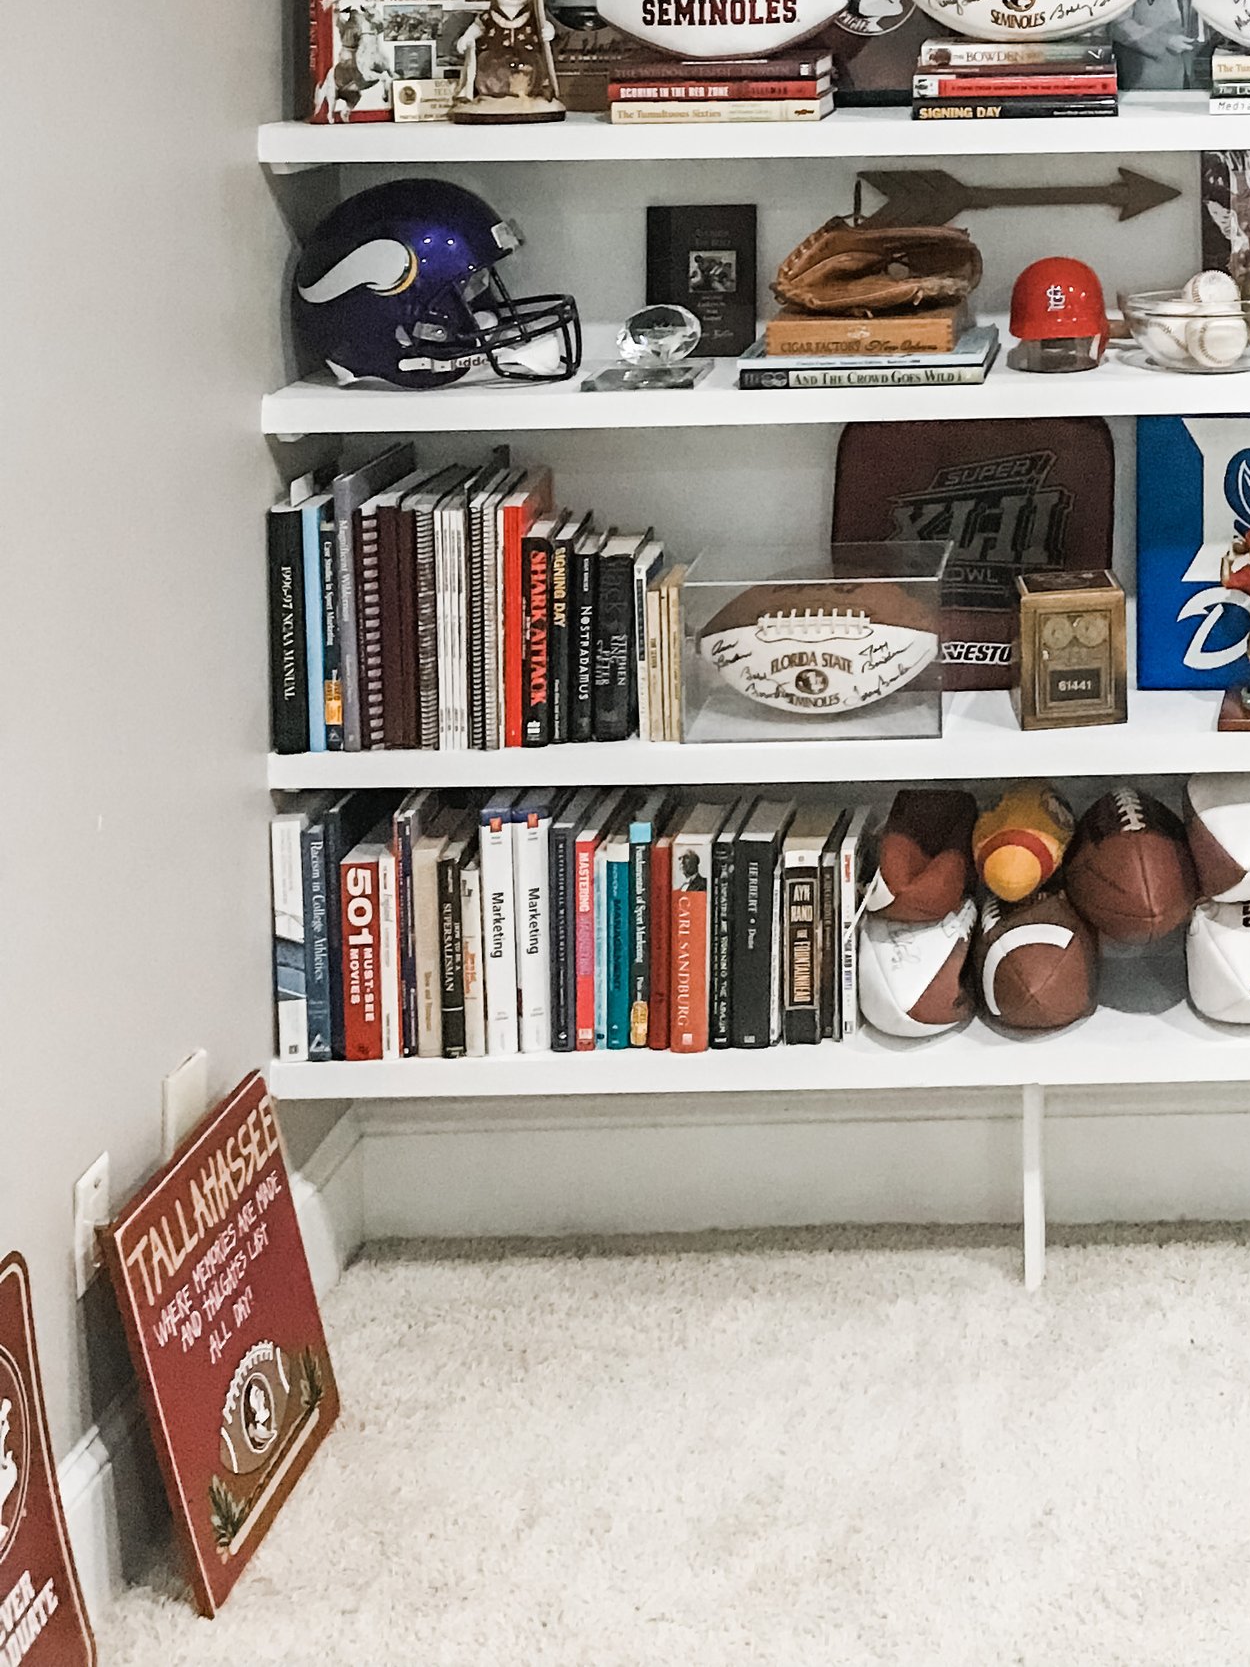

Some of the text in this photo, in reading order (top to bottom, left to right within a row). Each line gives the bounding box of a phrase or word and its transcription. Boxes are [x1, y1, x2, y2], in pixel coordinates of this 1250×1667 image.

[990, 9, 1046, 30] SEMINOLES
[966, 51, 1025, 63] BOWDEN
[1217, 63, 1234, 73] The
[617, 109, 722, 119] The Tumultuous Sixties
[671, 86, 686, 97] THE
[707, 86, 729, 97] ZONE
[918, 106, 1002, 119] SIGNING DAY
[781, 341, 860, 353] CIGAR FACTORY
[792, 370, 922, 385] AND THE CROWD GOES
[945, 460, 1031, 485] SUPER
[552, 547, 566, 628] SIGNING DAY
[280, 565, 296, 701] 1996-97 NCAA MANUAL
[325, 612, 336, 646] Marketing
[530, 550, 547, 707] SHARK ATTACK
[771, 651, 854, 675] FLORIDA STATE
[1057, 679, 1093, 692] 61441
[578, 852, 590, 912] MASTERING
[635, 845, 646, 895] Fundamentals
[748, 862, 758, 913] HERBERT
[309, 841, 327, 983] Racism in College Athletics
[491, 892, 505, 958] Marketing
[527, 887, 541, 954] Marketing
[634, 905, 646, 925] Sport
[346, 868, 375, 1022] 501 MUST-SEE
[443, 903, 454, 991] SUPERSALESMAN
[634, 927, 646, 963] Marketing
[677, 896, 692, 1026] CARL SANDBURG
[349, 948, 360, 1004] MOVIES
[793, 941, 812, 1003] FOUNTAINHEAD
[127, 1094, 278, 1306] TALLAHASSEE
[152, 1170, 282, 1347] WHERE MEMORIES ARE MADE
[180, 1310, 202, 1353] AND
[247, 1222, 269, 1261] LAST
[209, 1320, 232, 1364] ALL
